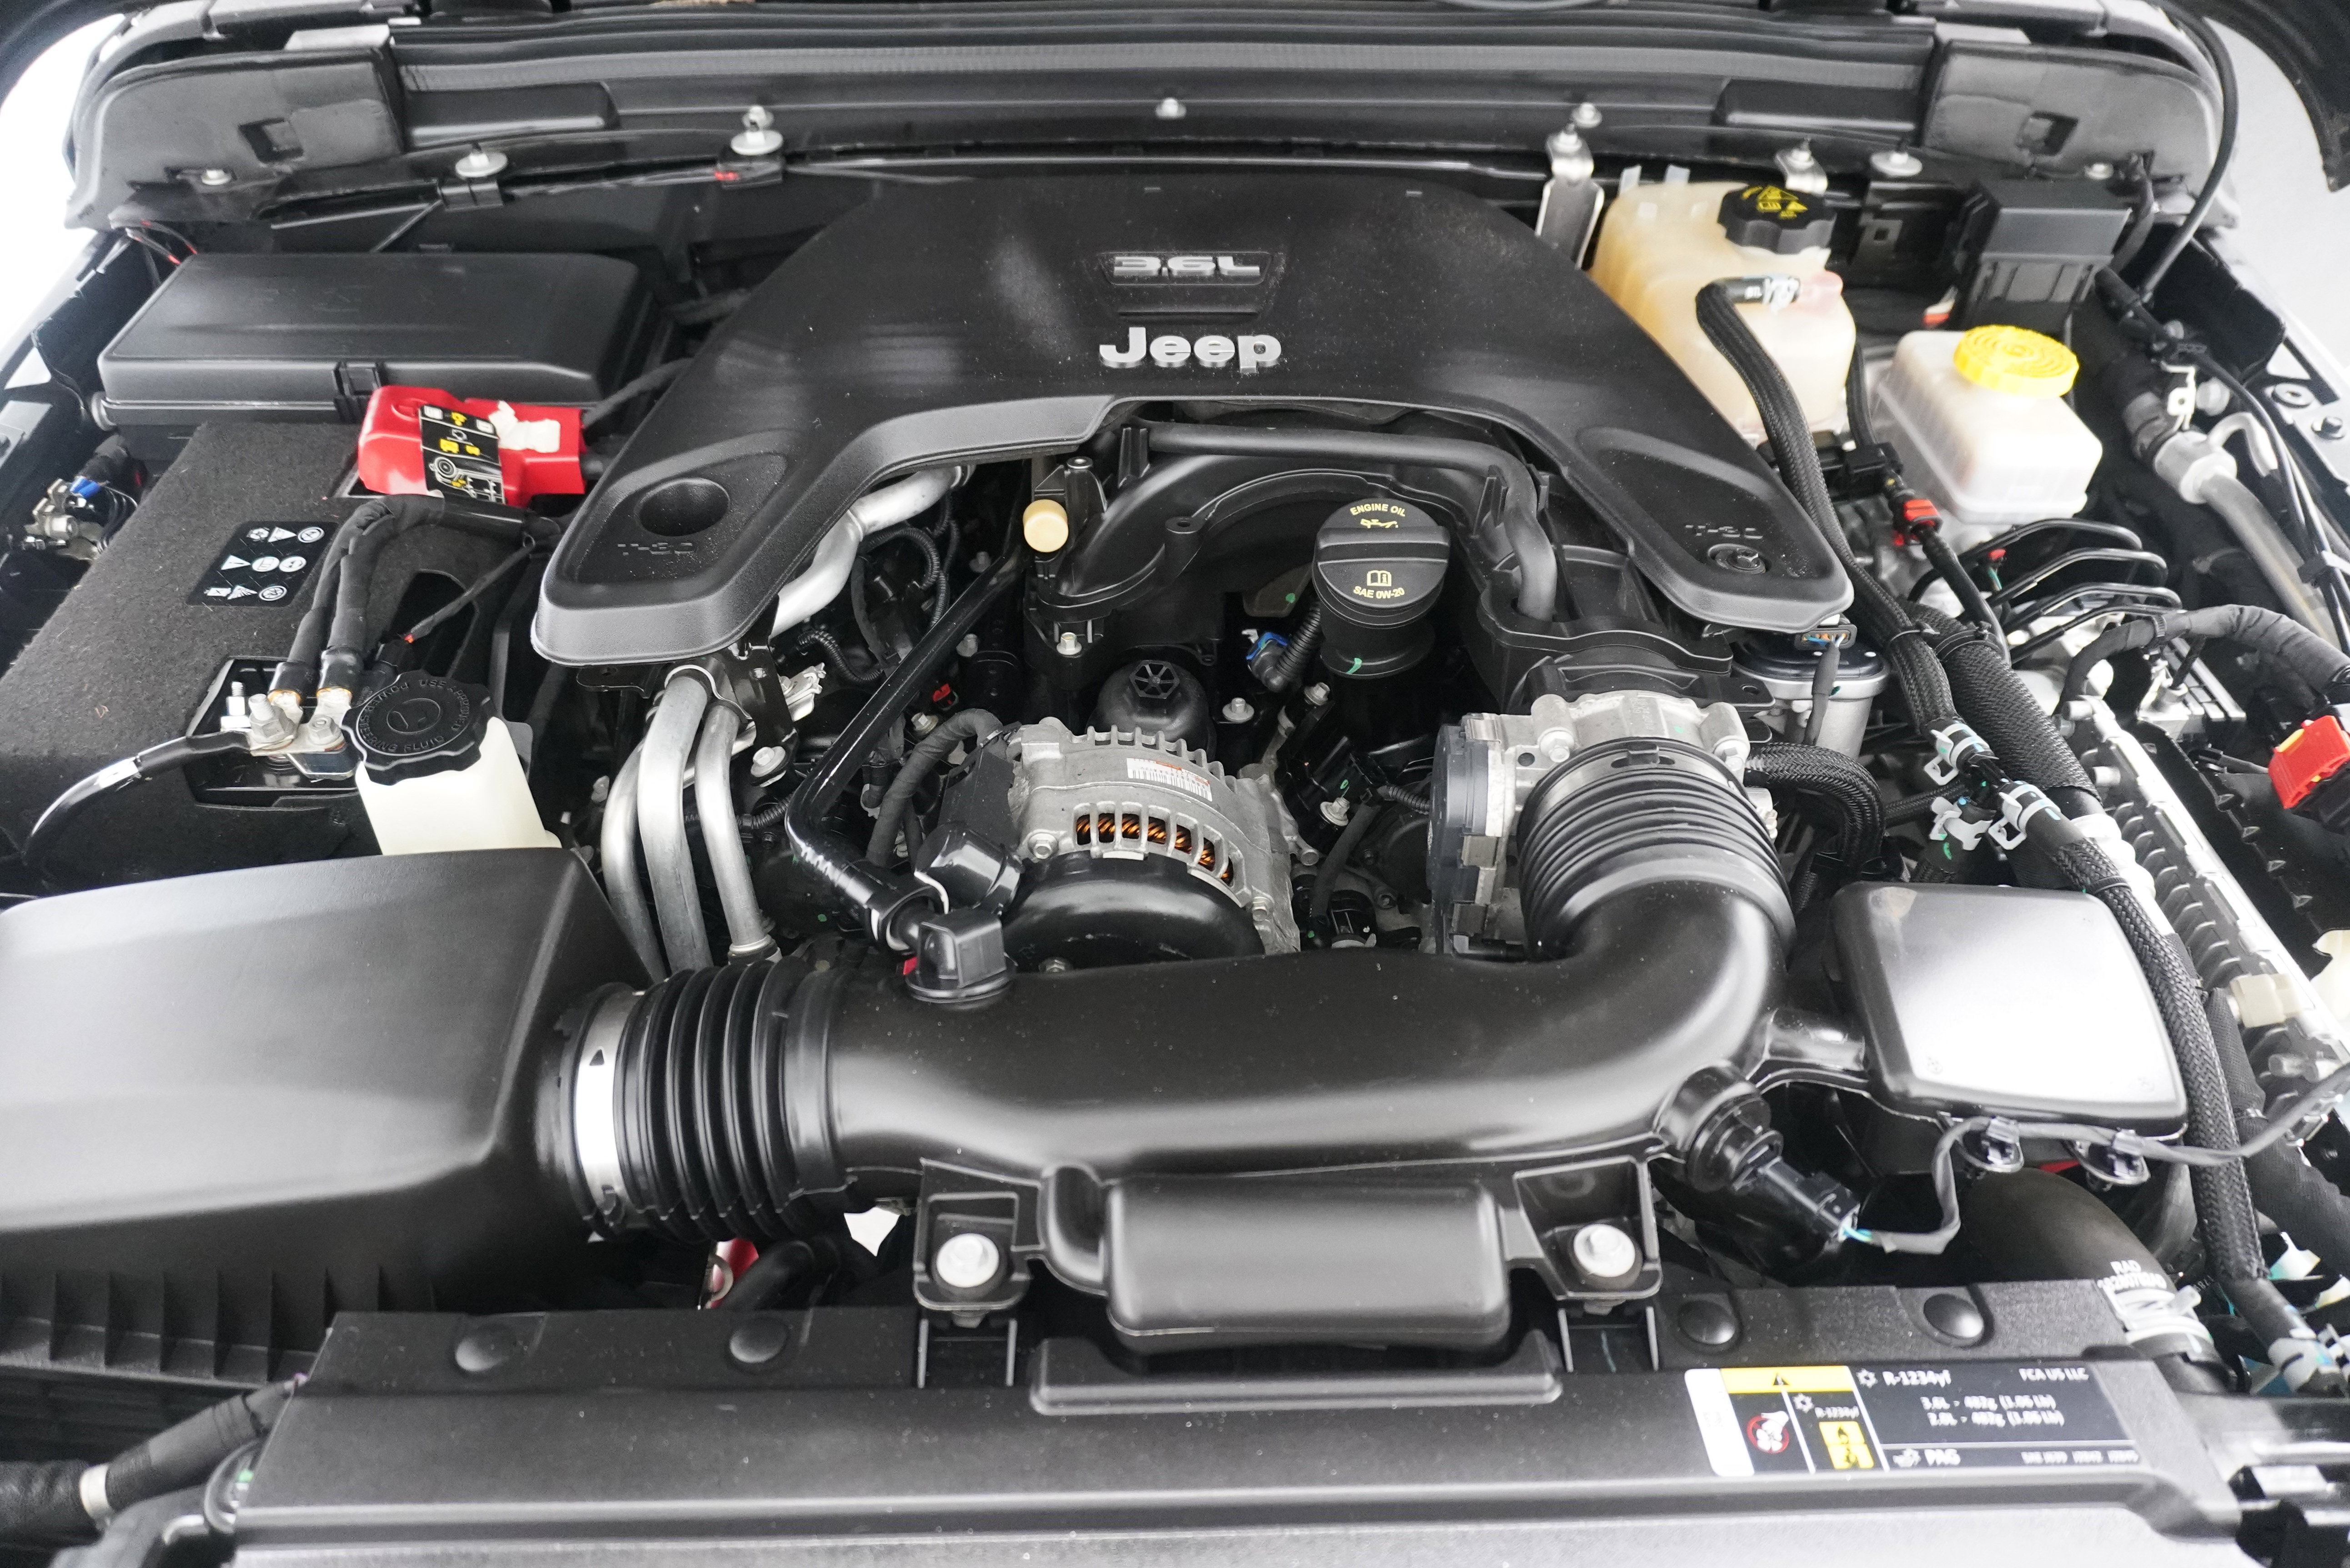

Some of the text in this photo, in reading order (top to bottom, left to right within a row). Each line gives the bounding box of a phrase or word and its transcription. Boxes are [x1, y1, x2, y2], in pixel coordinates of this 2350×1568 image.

[1113, 256, 1260, 276] 3.6L
[1099, 327, 1282, 374] Jeep
[1350, 503, 1406, 517] ENGINE OIL
[1353, 586, 1405, 599] SAE 0W-20
[365, 682, 409, 713] POWER
[418, 679, 471, 732] USE APPROVED
[359, 714, 398, 753] STEERING
[404, 735, 446, 753] FLUID
[2110, 1260, 2142, 1274] RAD
[1882, 1369, 1952, 1388] R-1234yf
[2019, 1367, 2089, 1382] FCA US LLC
